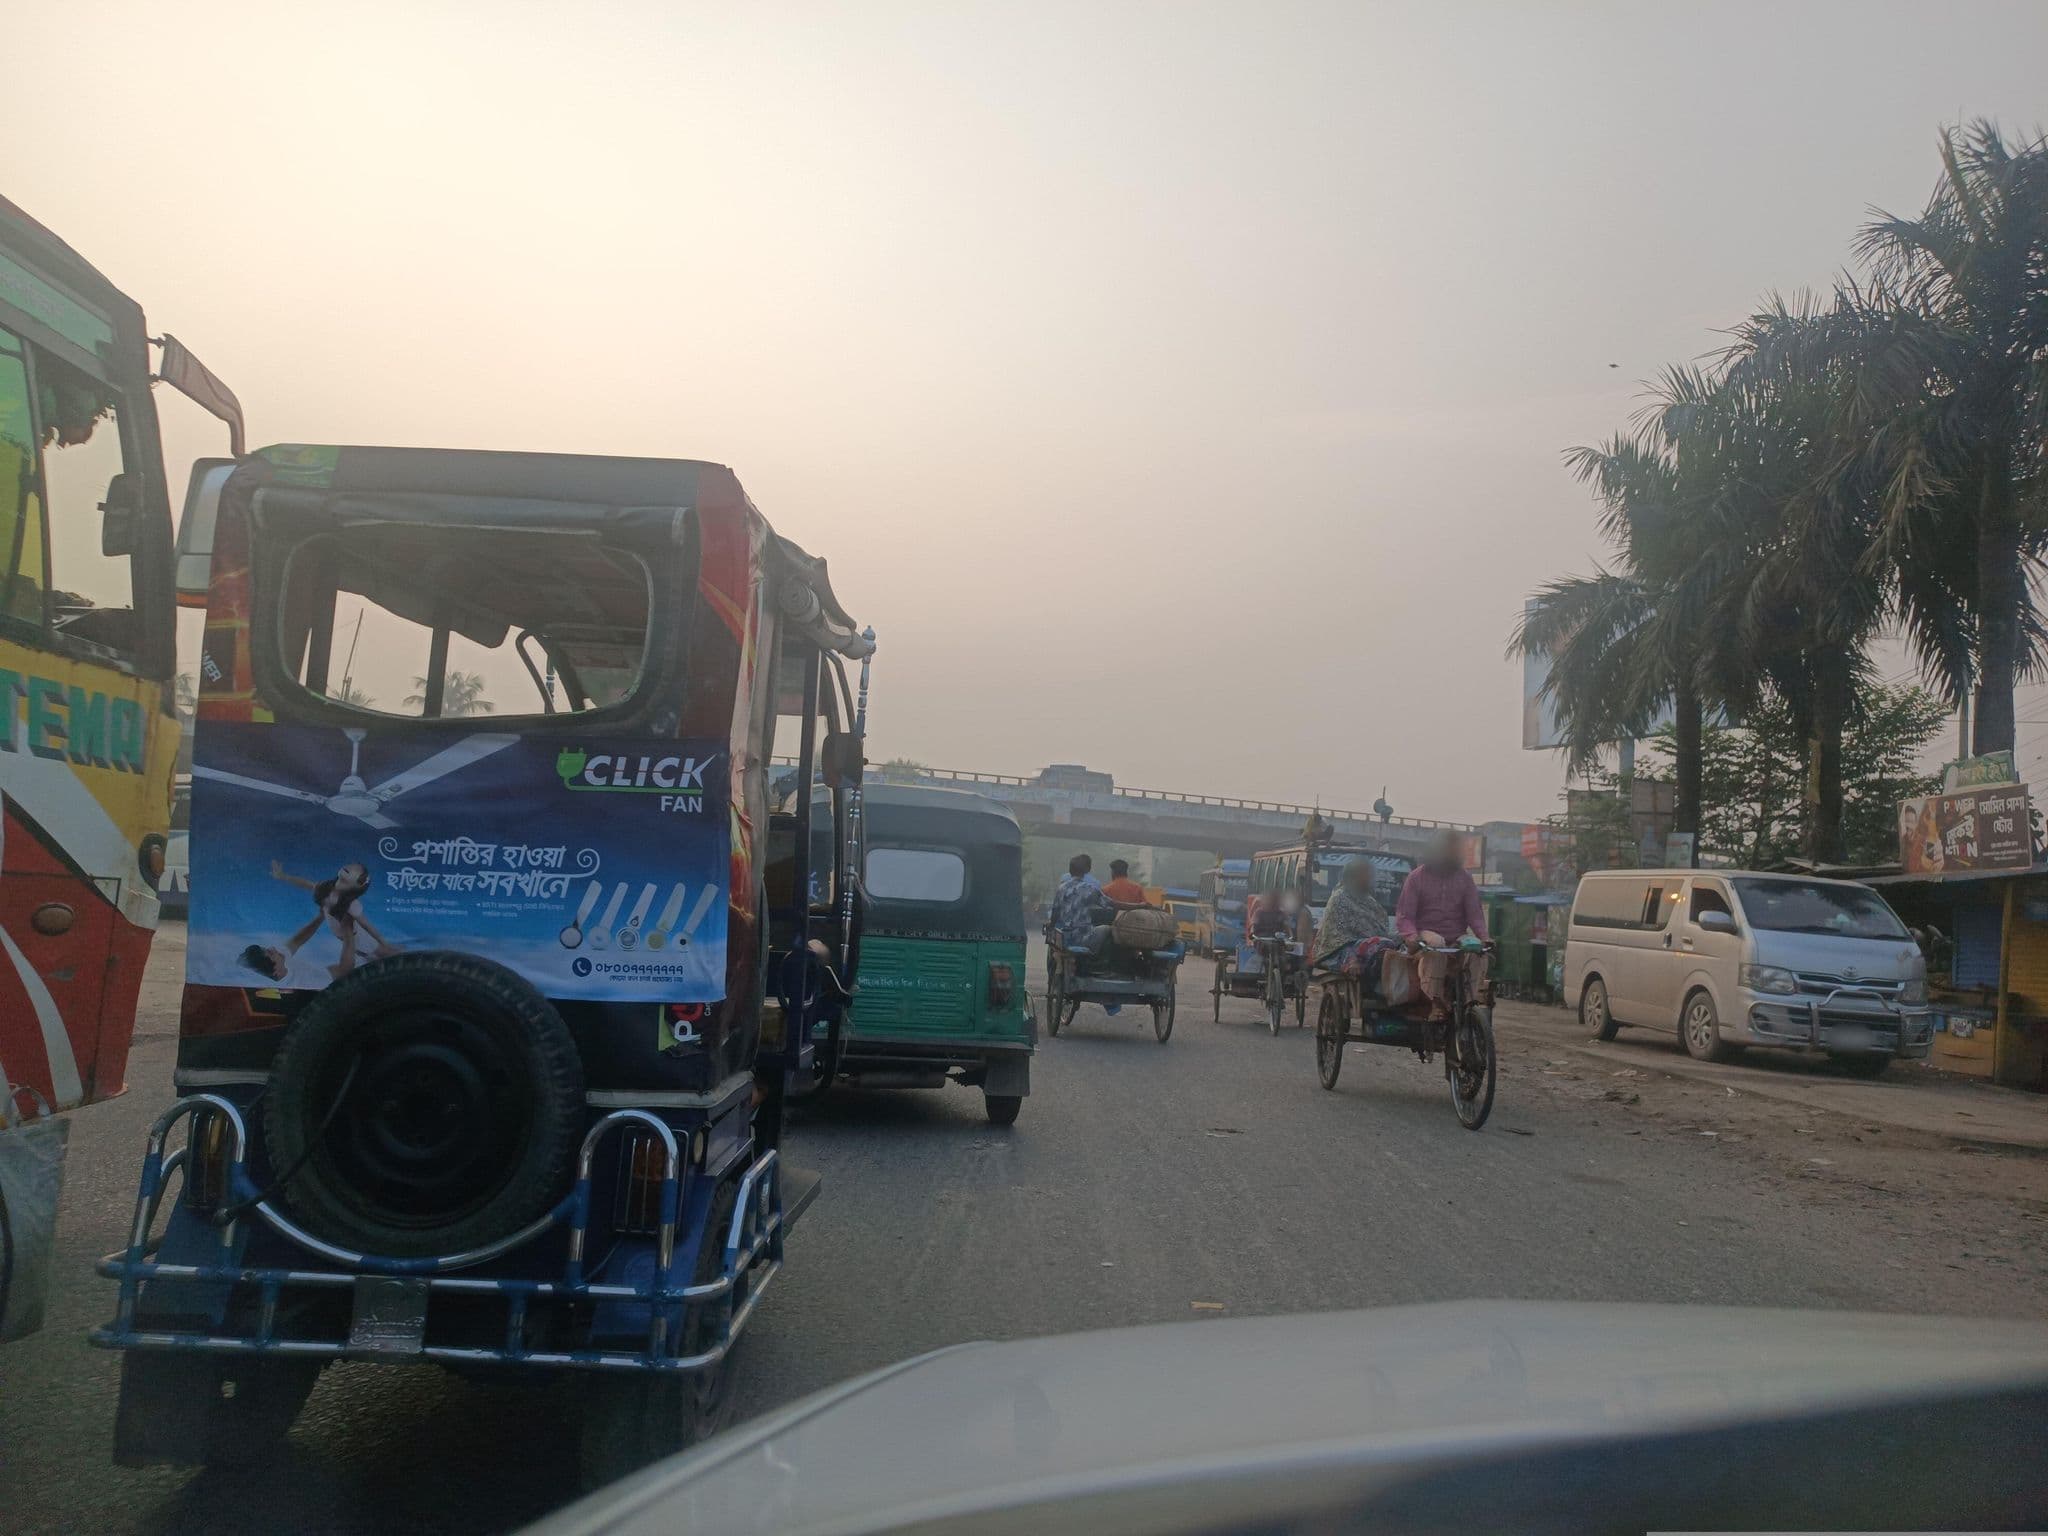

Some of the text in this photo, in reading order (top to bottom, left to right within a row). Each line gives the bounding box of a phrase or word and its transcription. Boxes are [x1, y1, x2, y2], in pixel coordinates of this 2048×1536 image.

[584, 753, 718, 788] CLICK
[660, 796, 703, 813] FAN
[411, 836, 567, 869] প্রশান্তির হাওয়া
[386, 867, 572, 898] ছড়িয়ে যাবে সবখানে
